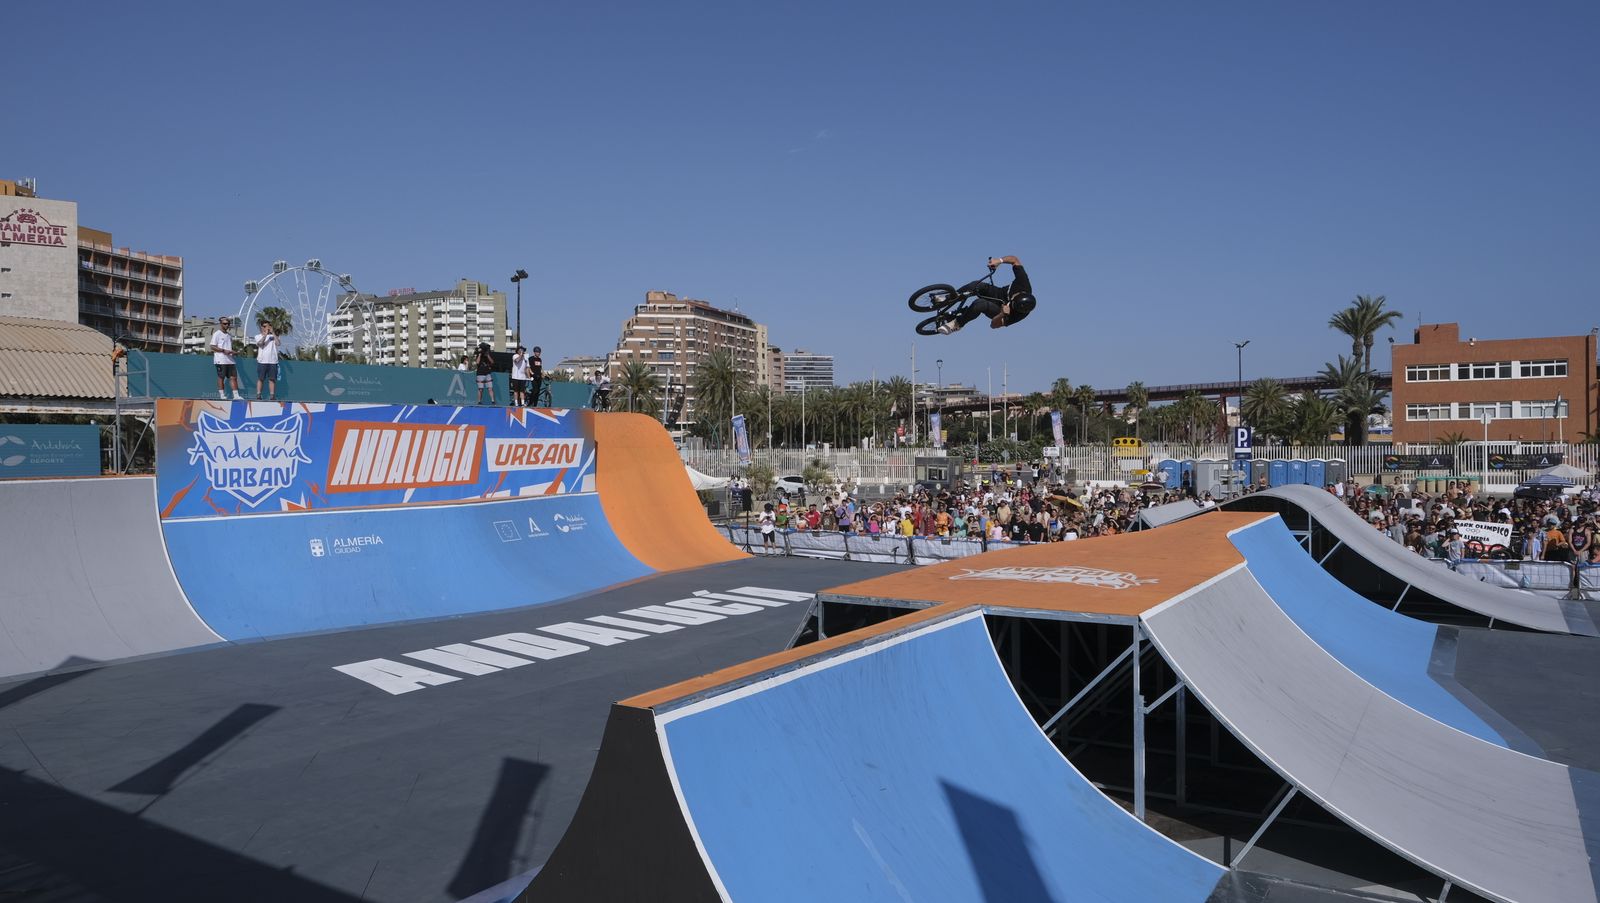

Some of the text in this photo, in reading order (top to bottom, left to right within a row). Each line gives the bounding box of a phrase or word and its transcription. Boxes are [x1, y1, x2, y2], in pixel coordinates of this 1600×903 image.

[0, 231, 64, 246] LMERIA
[28, 225, 67, 236] HOTEL
[192, 433, 311, 463] Andalucía
[330, 424, 577, 486] ANDALUCÍA URBAN
[214, 467, 290, 488] URBAN
[333, 534, 383, 547] ALMERÍA
[331, 586, 815, 695] ANDALUCÍA
